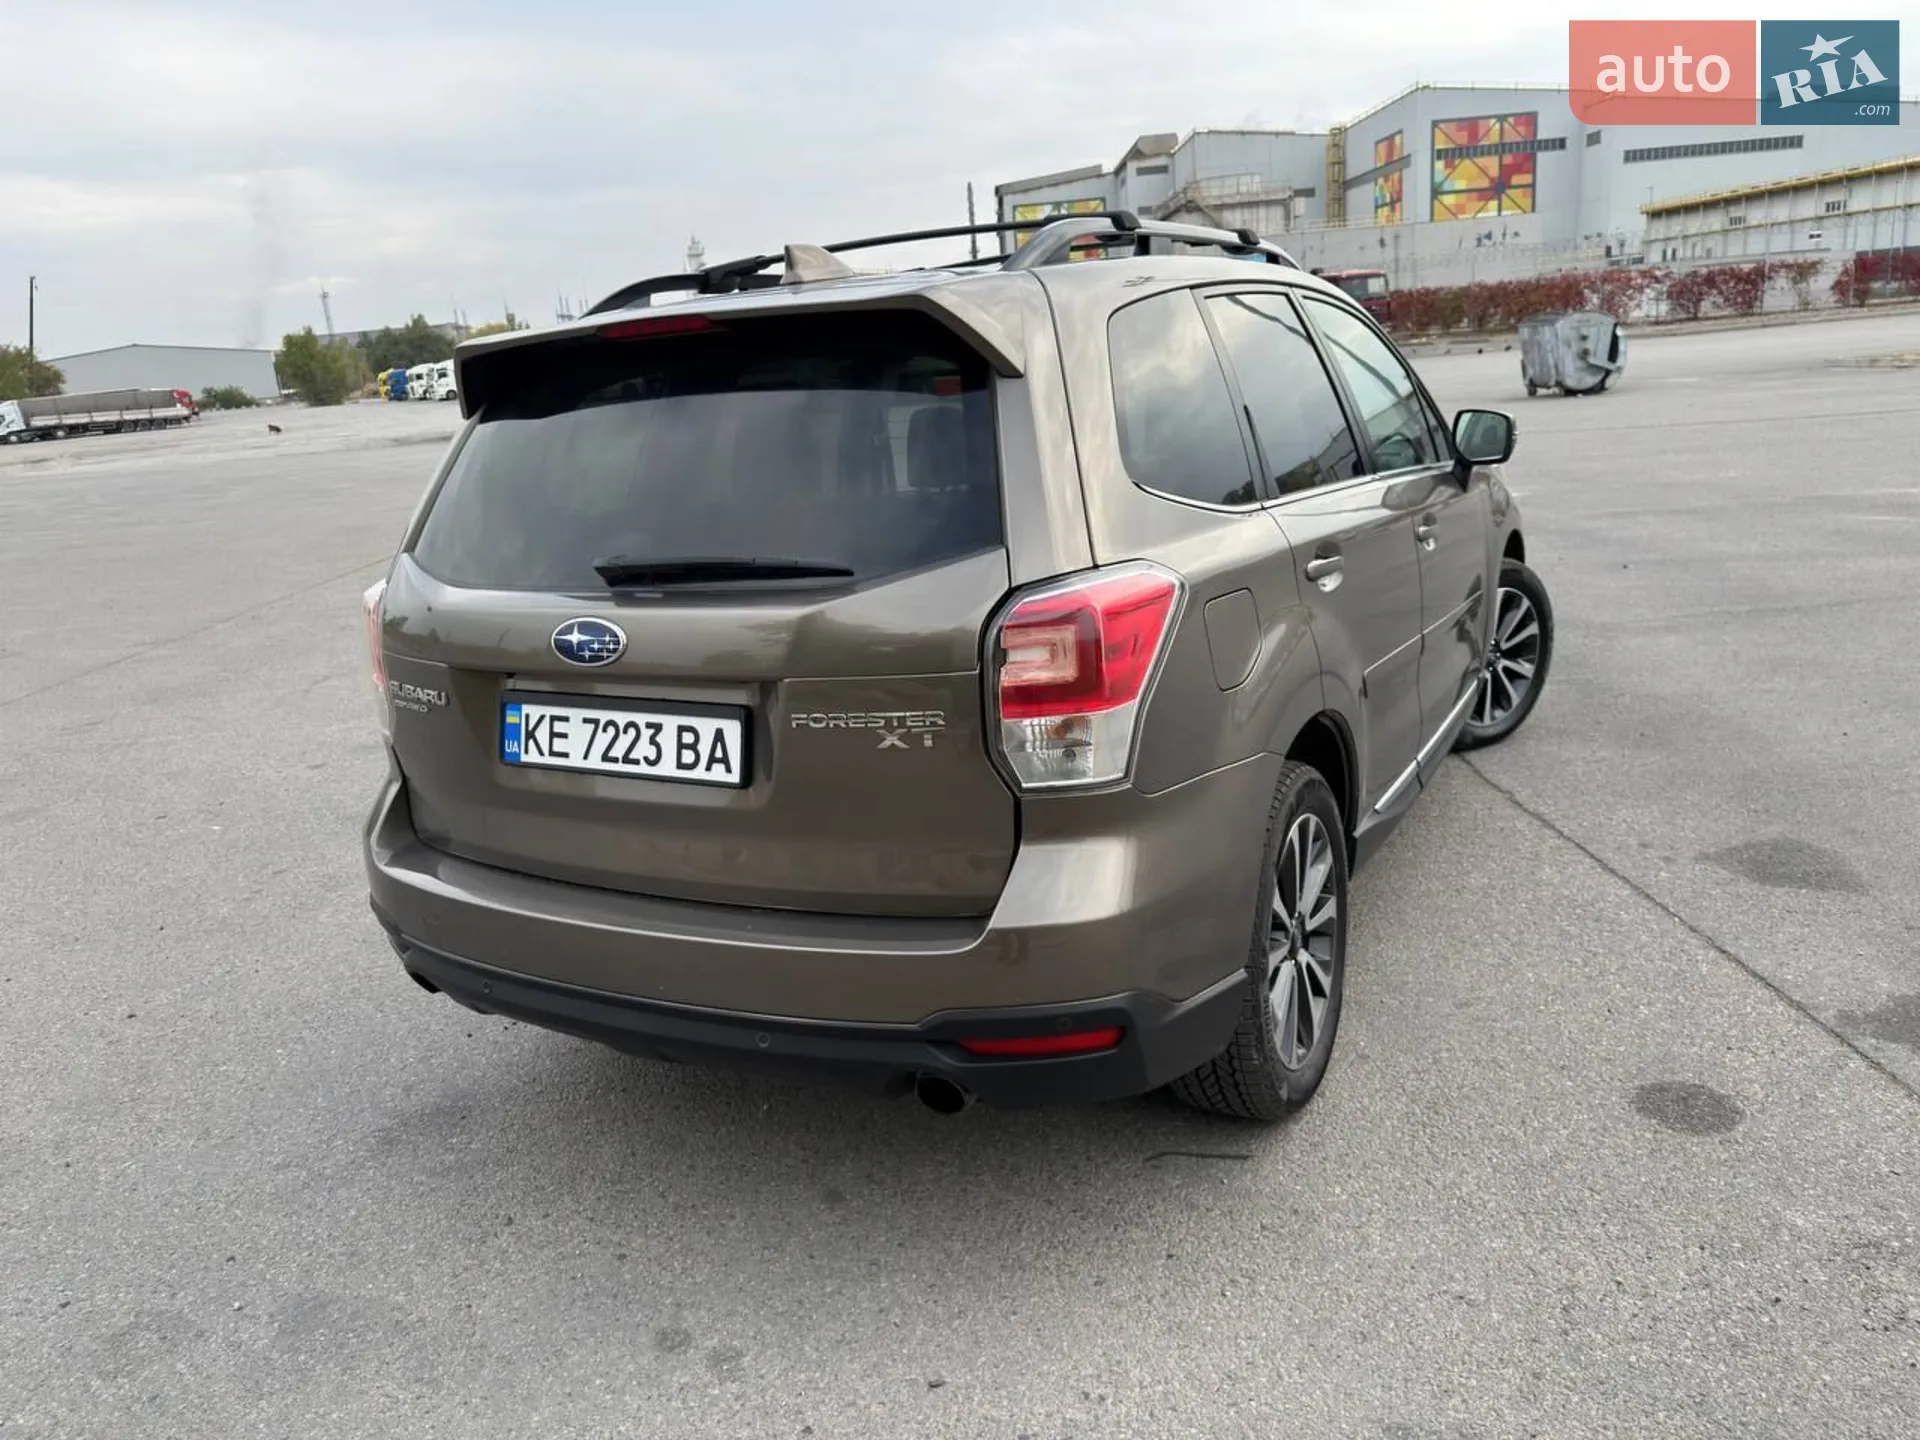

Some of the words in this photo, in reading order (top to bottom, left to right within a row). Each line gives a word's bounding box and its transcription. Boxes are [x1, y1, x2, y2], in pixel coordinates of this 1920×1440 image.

[791, 710, 946, 729] FORESTER
[504, 740, 520, 754] UA
[523, 712, 571, 759] KE
[581, 716, 664, 768] 7223
[675, 723, 734, 775] BA
[875, 727, 946, 750] XT
